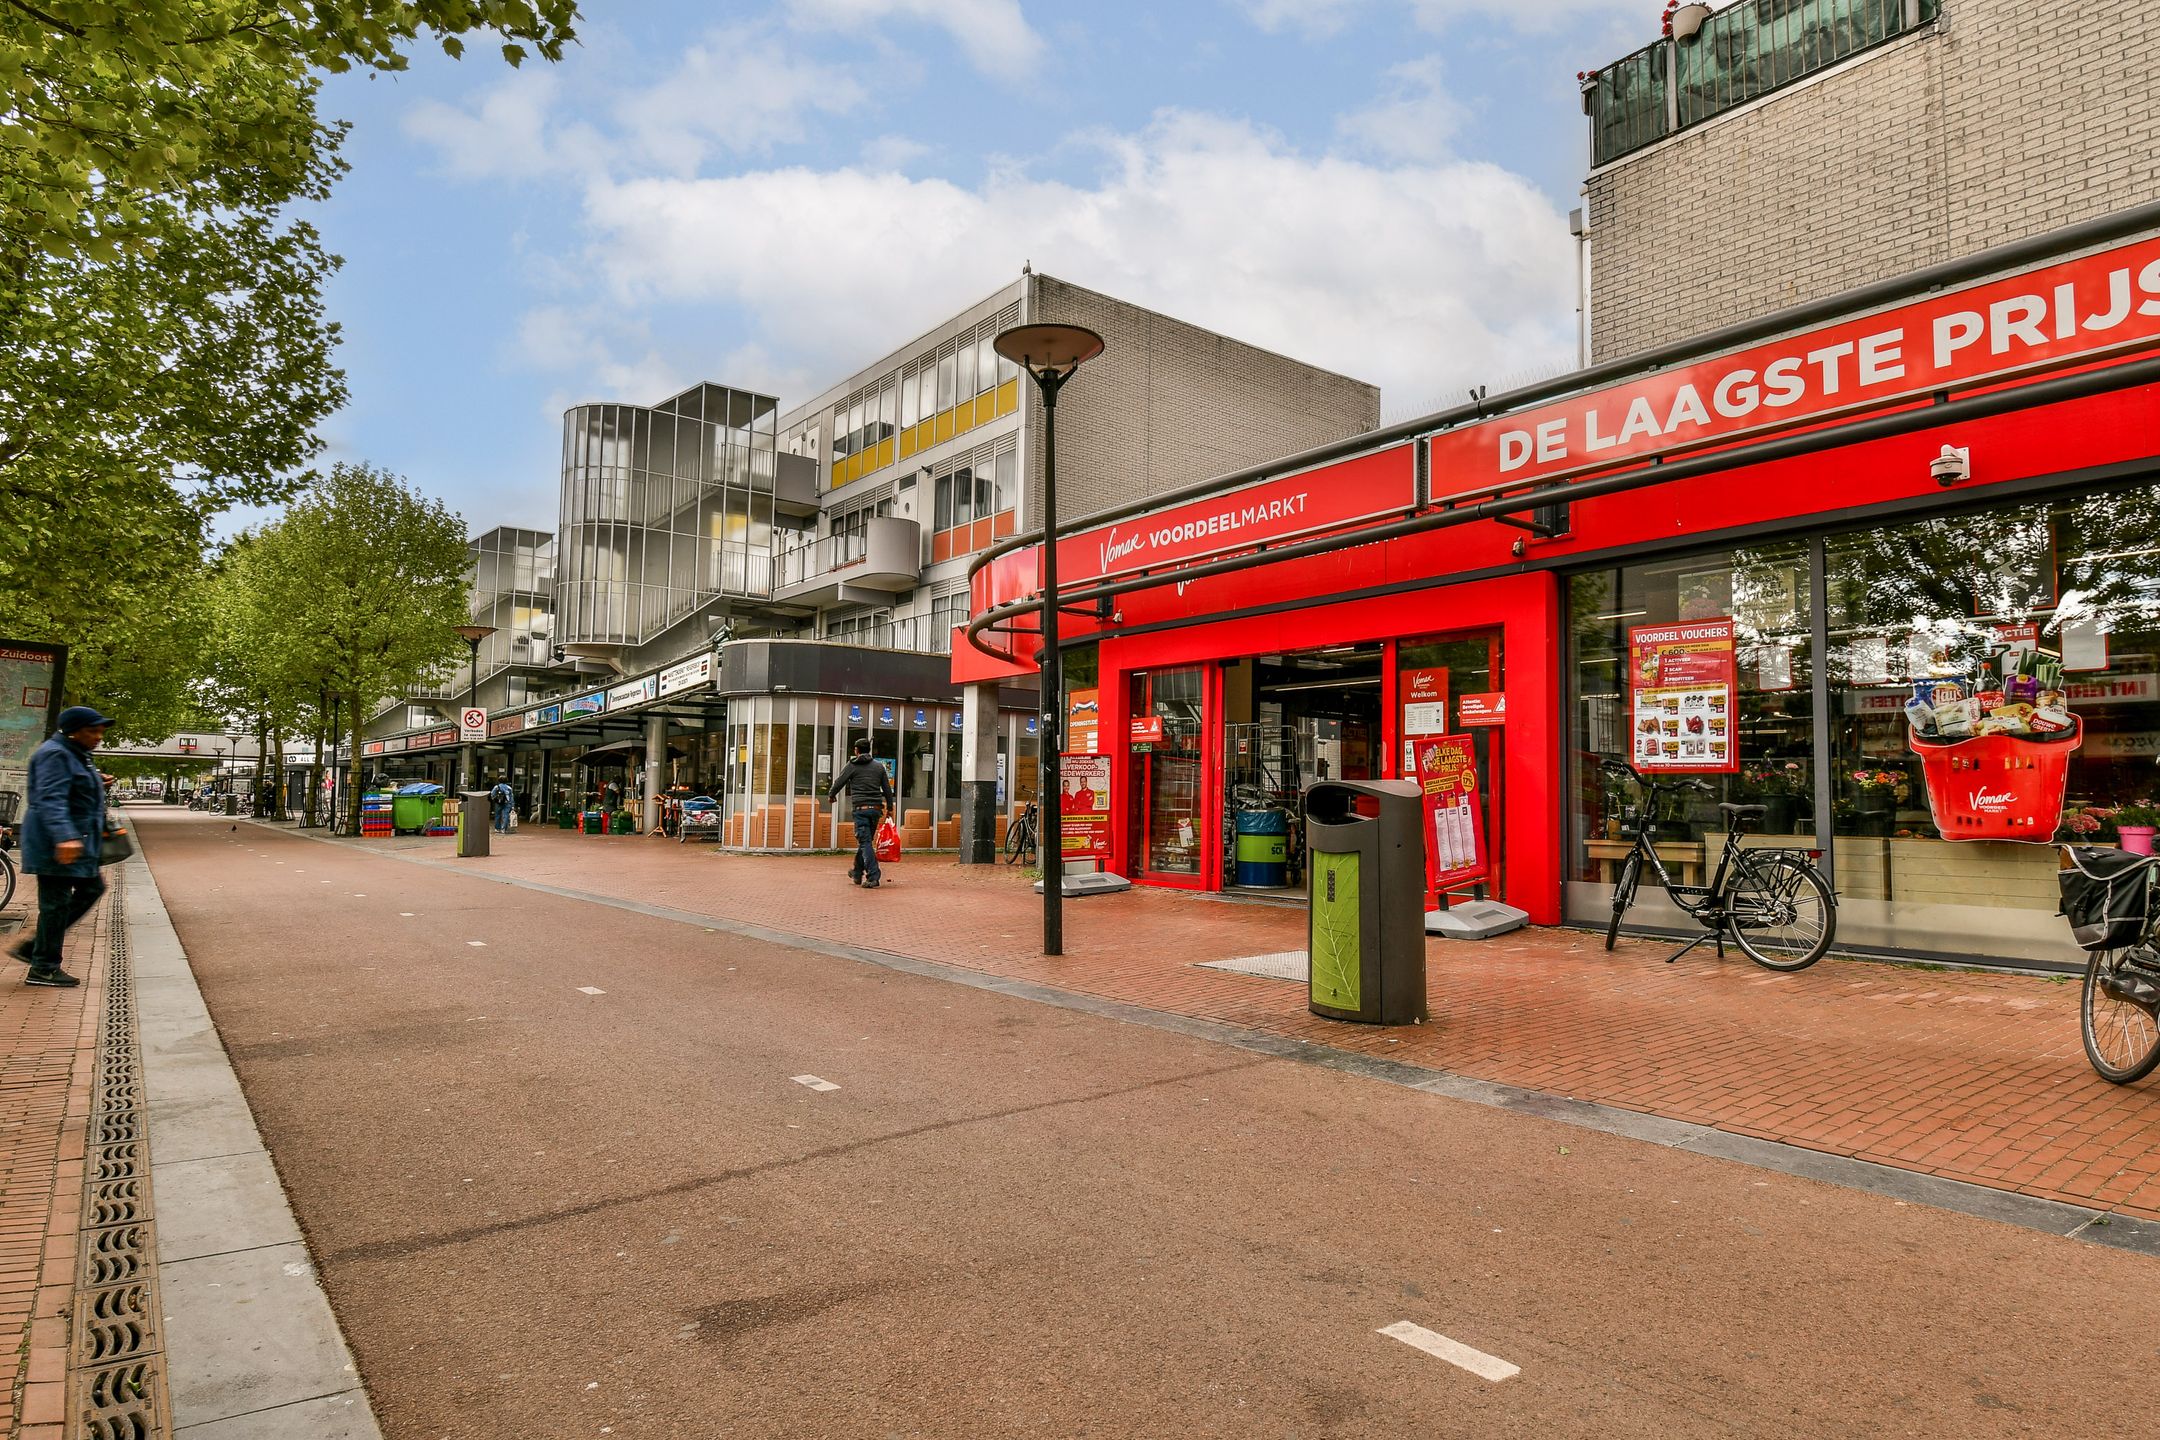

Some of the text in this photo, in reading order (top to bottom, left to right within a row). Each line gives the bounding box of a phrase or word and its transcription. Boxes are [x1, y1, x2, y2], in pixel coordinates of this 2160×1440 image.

[1500, 269, 2160, 474] DE LAAGSTE PRIJS
[1100, 493, 1308, 574] Vomar VOORDEELMARKT
[1635, 627, 1728, 643] VOORDEEL VOUCHERS
[1998, 627, 2035, 640] ACTIE!
[1, 649, 54, 662] Zuidoost
[1410, 691, 1438, 699] Welkom
[1070, 719, 1099, 728] OPENINGSTIJDE
[1435, 746, 1463, 757] ELKE DAG
[1441, 754, 1468, 765] LAAGSTE
[1968, 785, 2018, 811] Vomar
